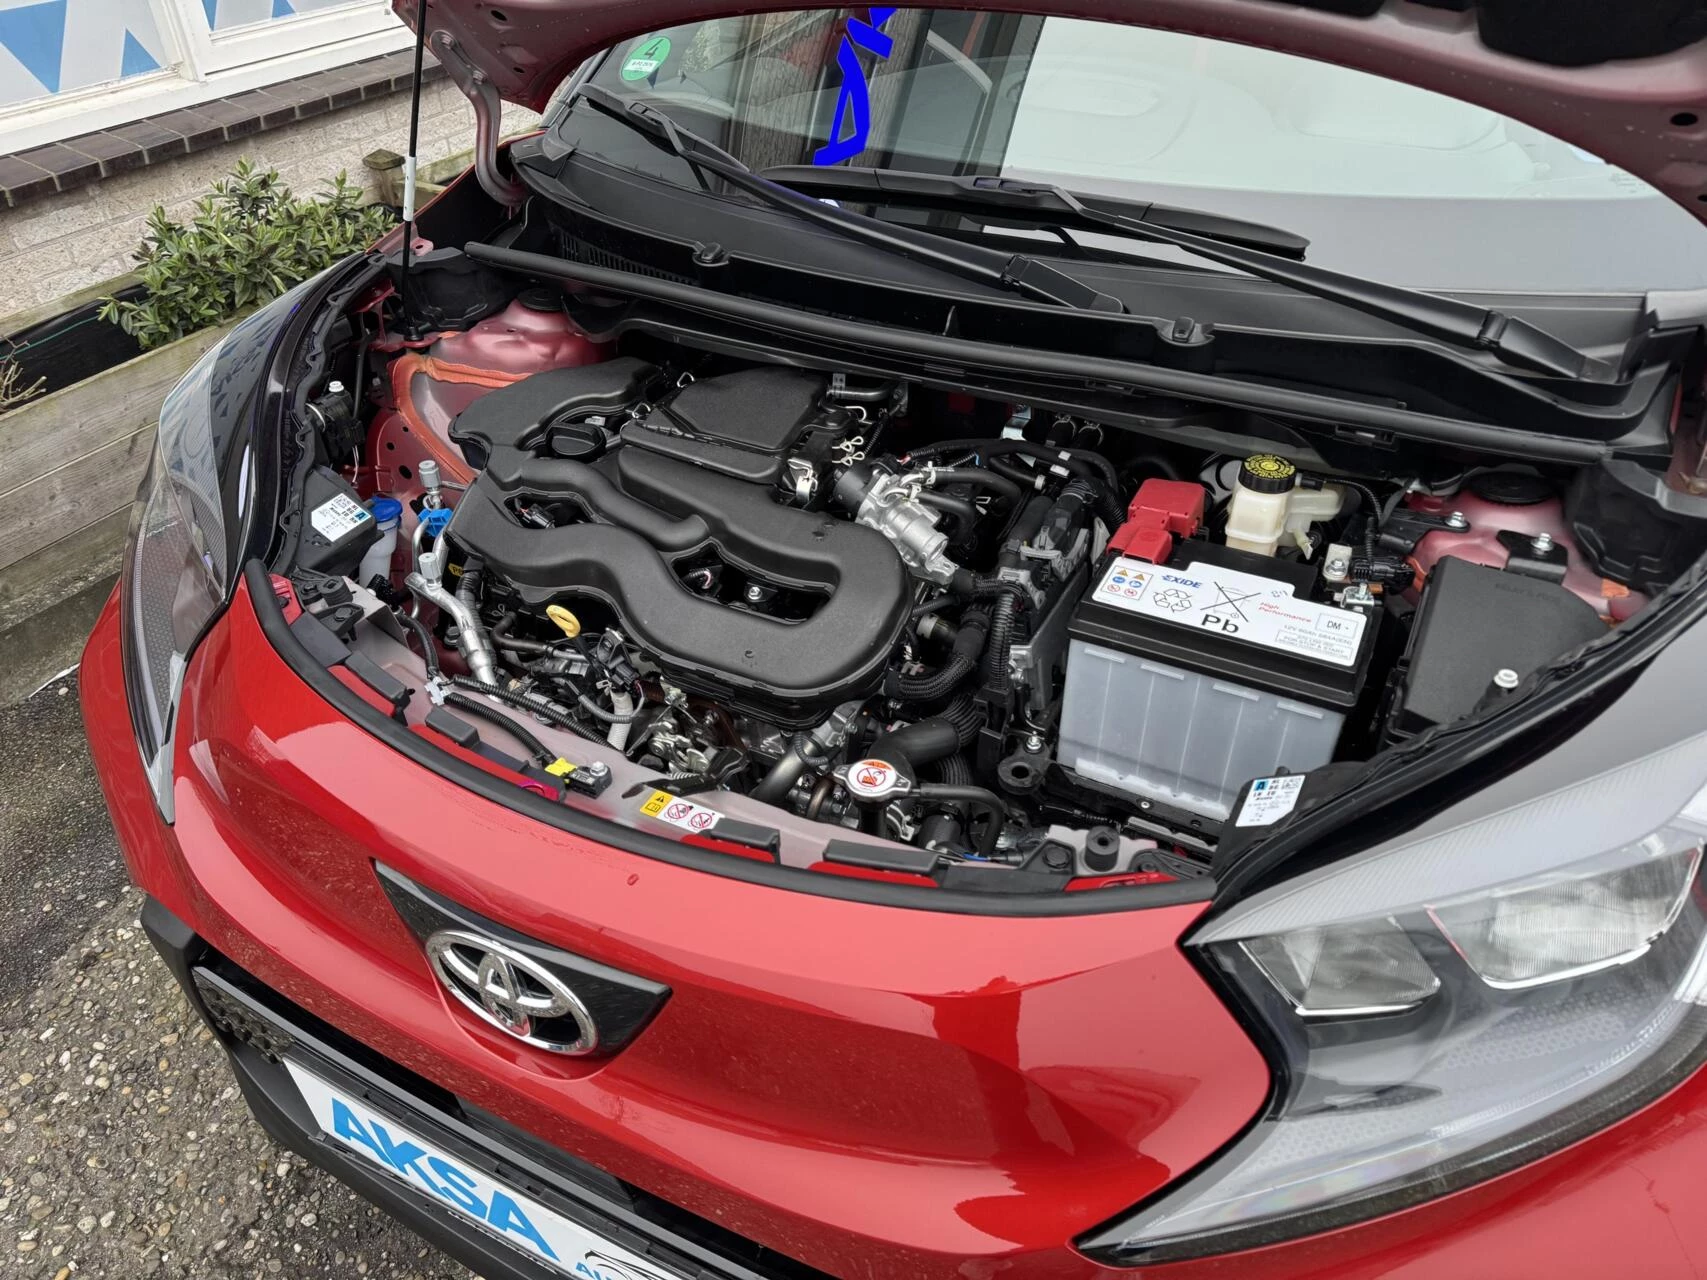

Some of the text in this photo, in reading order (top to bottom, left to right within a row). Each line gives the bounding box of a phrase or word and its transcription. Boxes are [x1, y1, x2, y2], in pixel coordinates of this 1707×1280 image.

[644, 39, 664, 59] 4
[1161, 574, 1203, 589] EXIDE
[1201, 613, 1240, 633] Pb
[332, 1097, 561, 1262] AKSA
